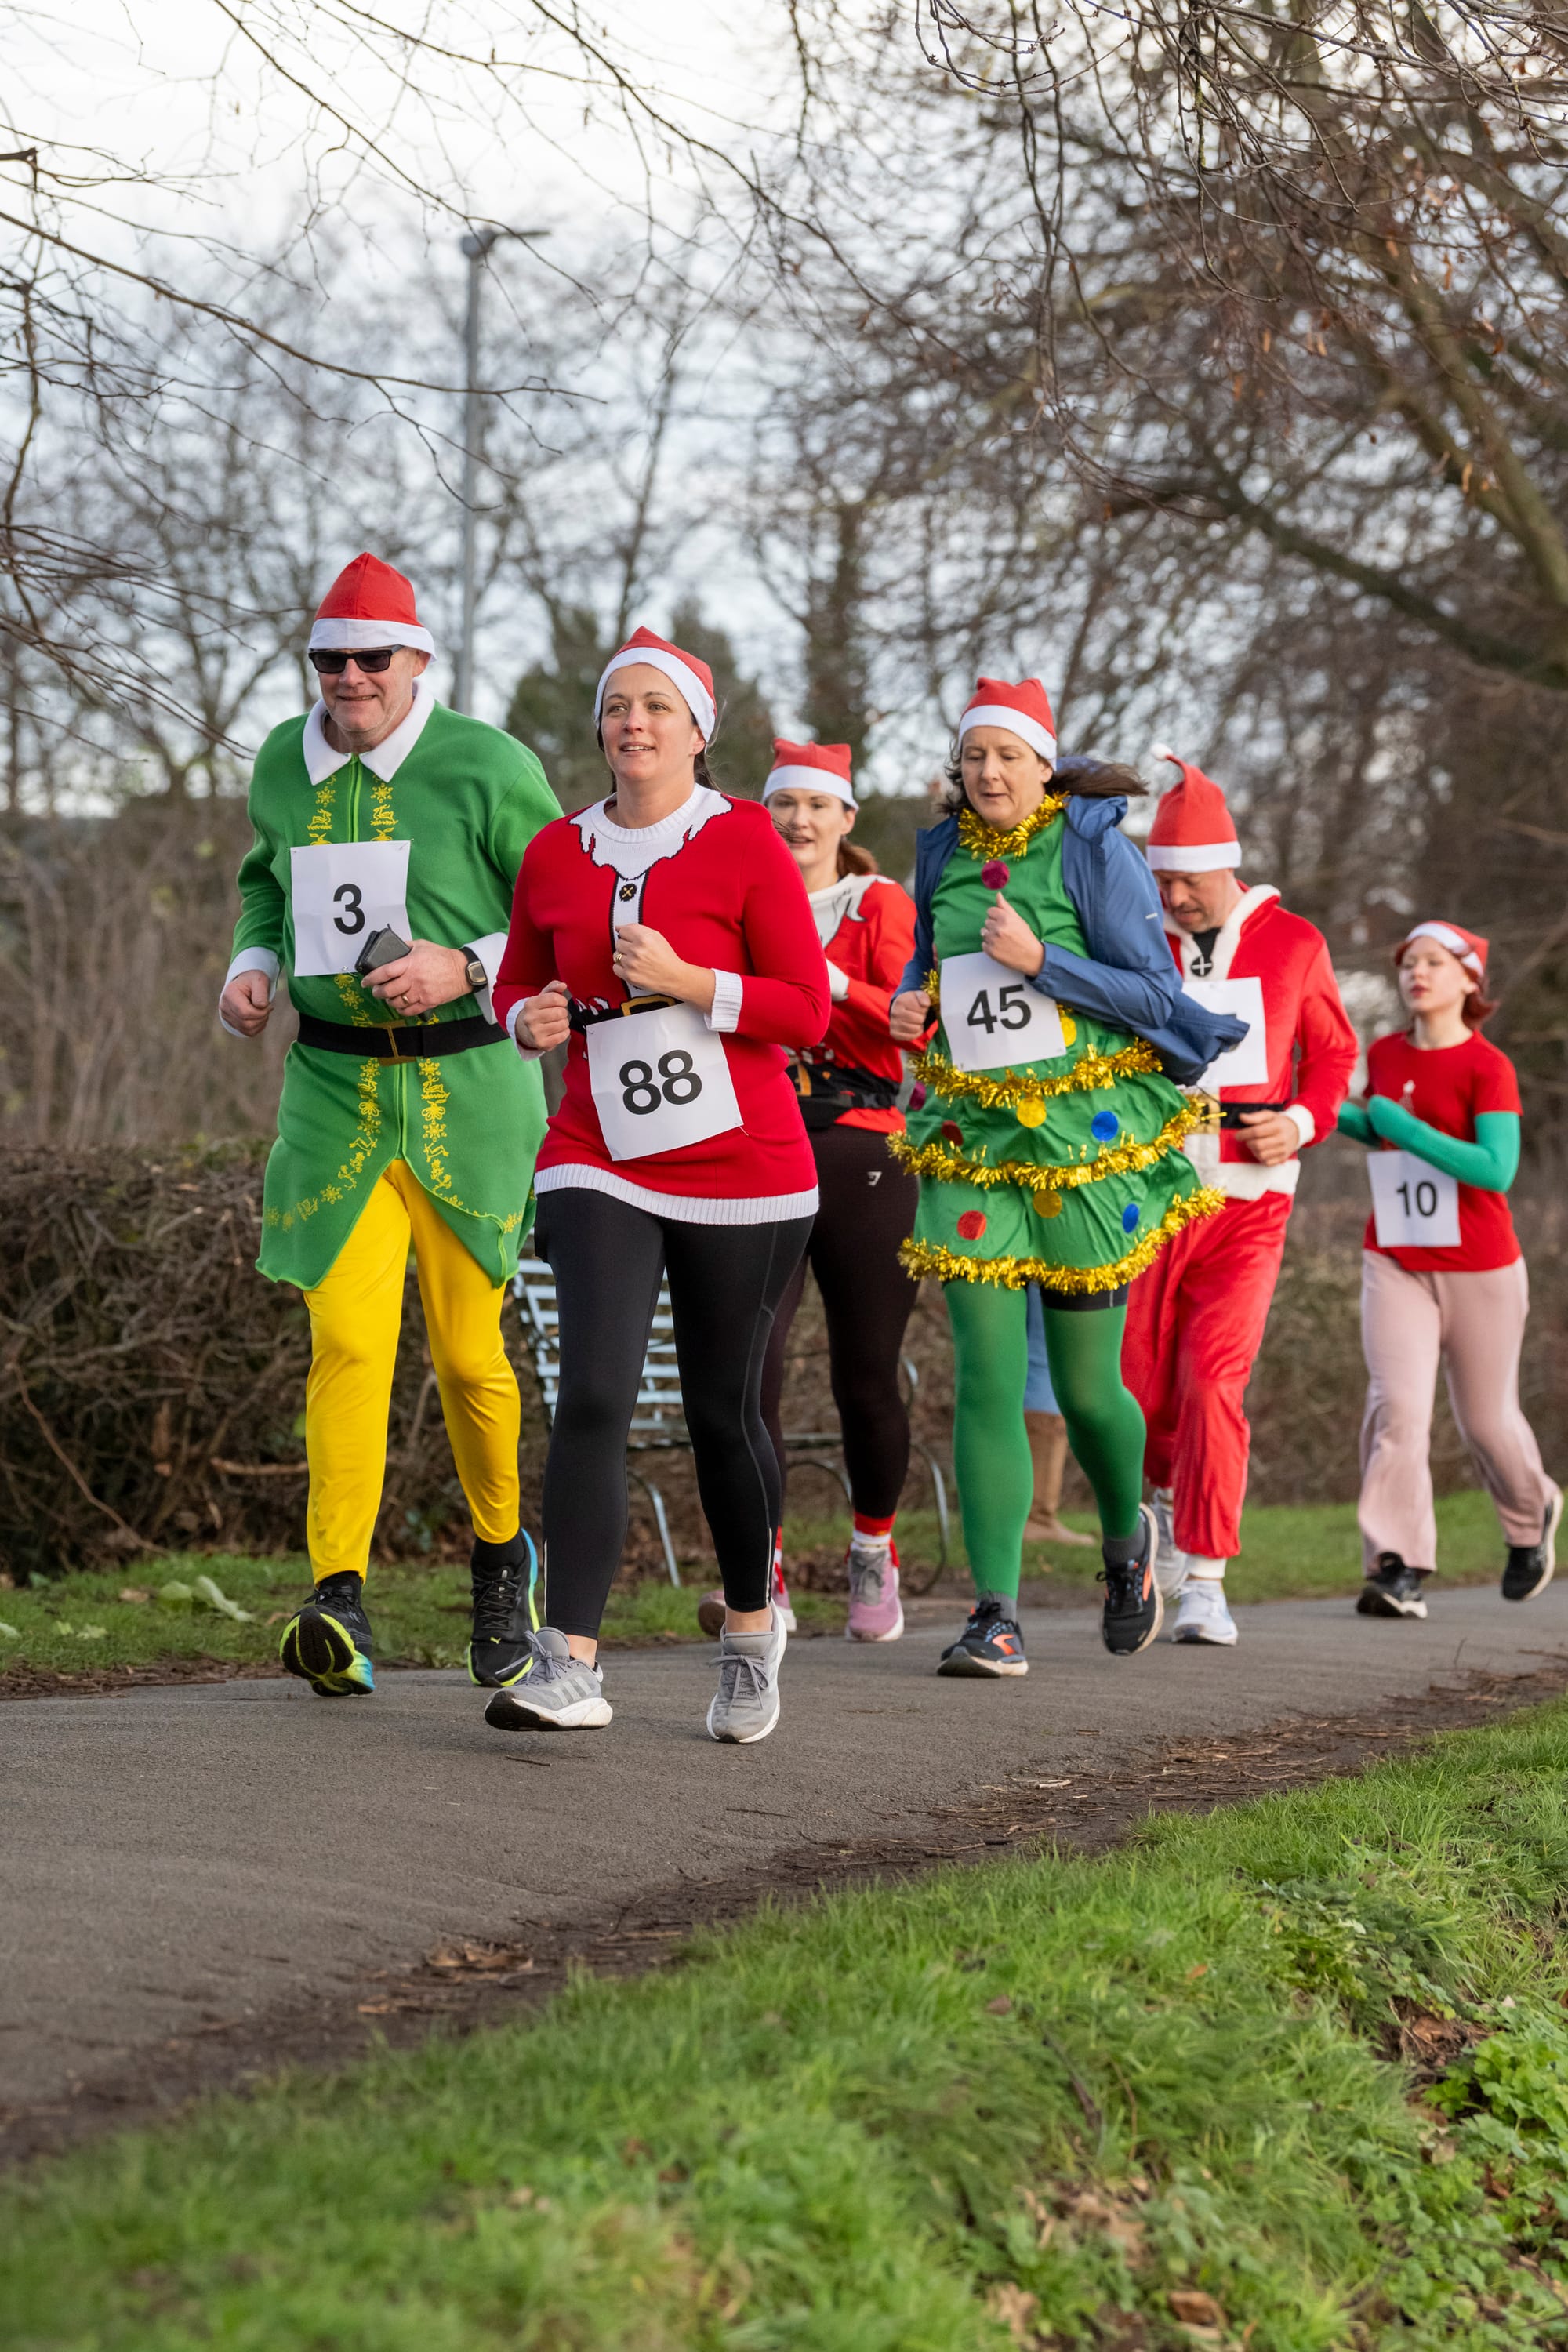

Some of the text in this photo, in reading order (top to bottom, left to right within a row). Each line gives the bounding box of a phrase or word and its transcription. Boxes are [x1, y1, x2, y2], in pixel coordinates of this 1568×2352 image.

[332, 884, 365, 935] 3
[967, 983, 1031, 1034] 45
[619, 1049, 702, 1115] 88
[1396, 1181, 1437, 1217] 10
